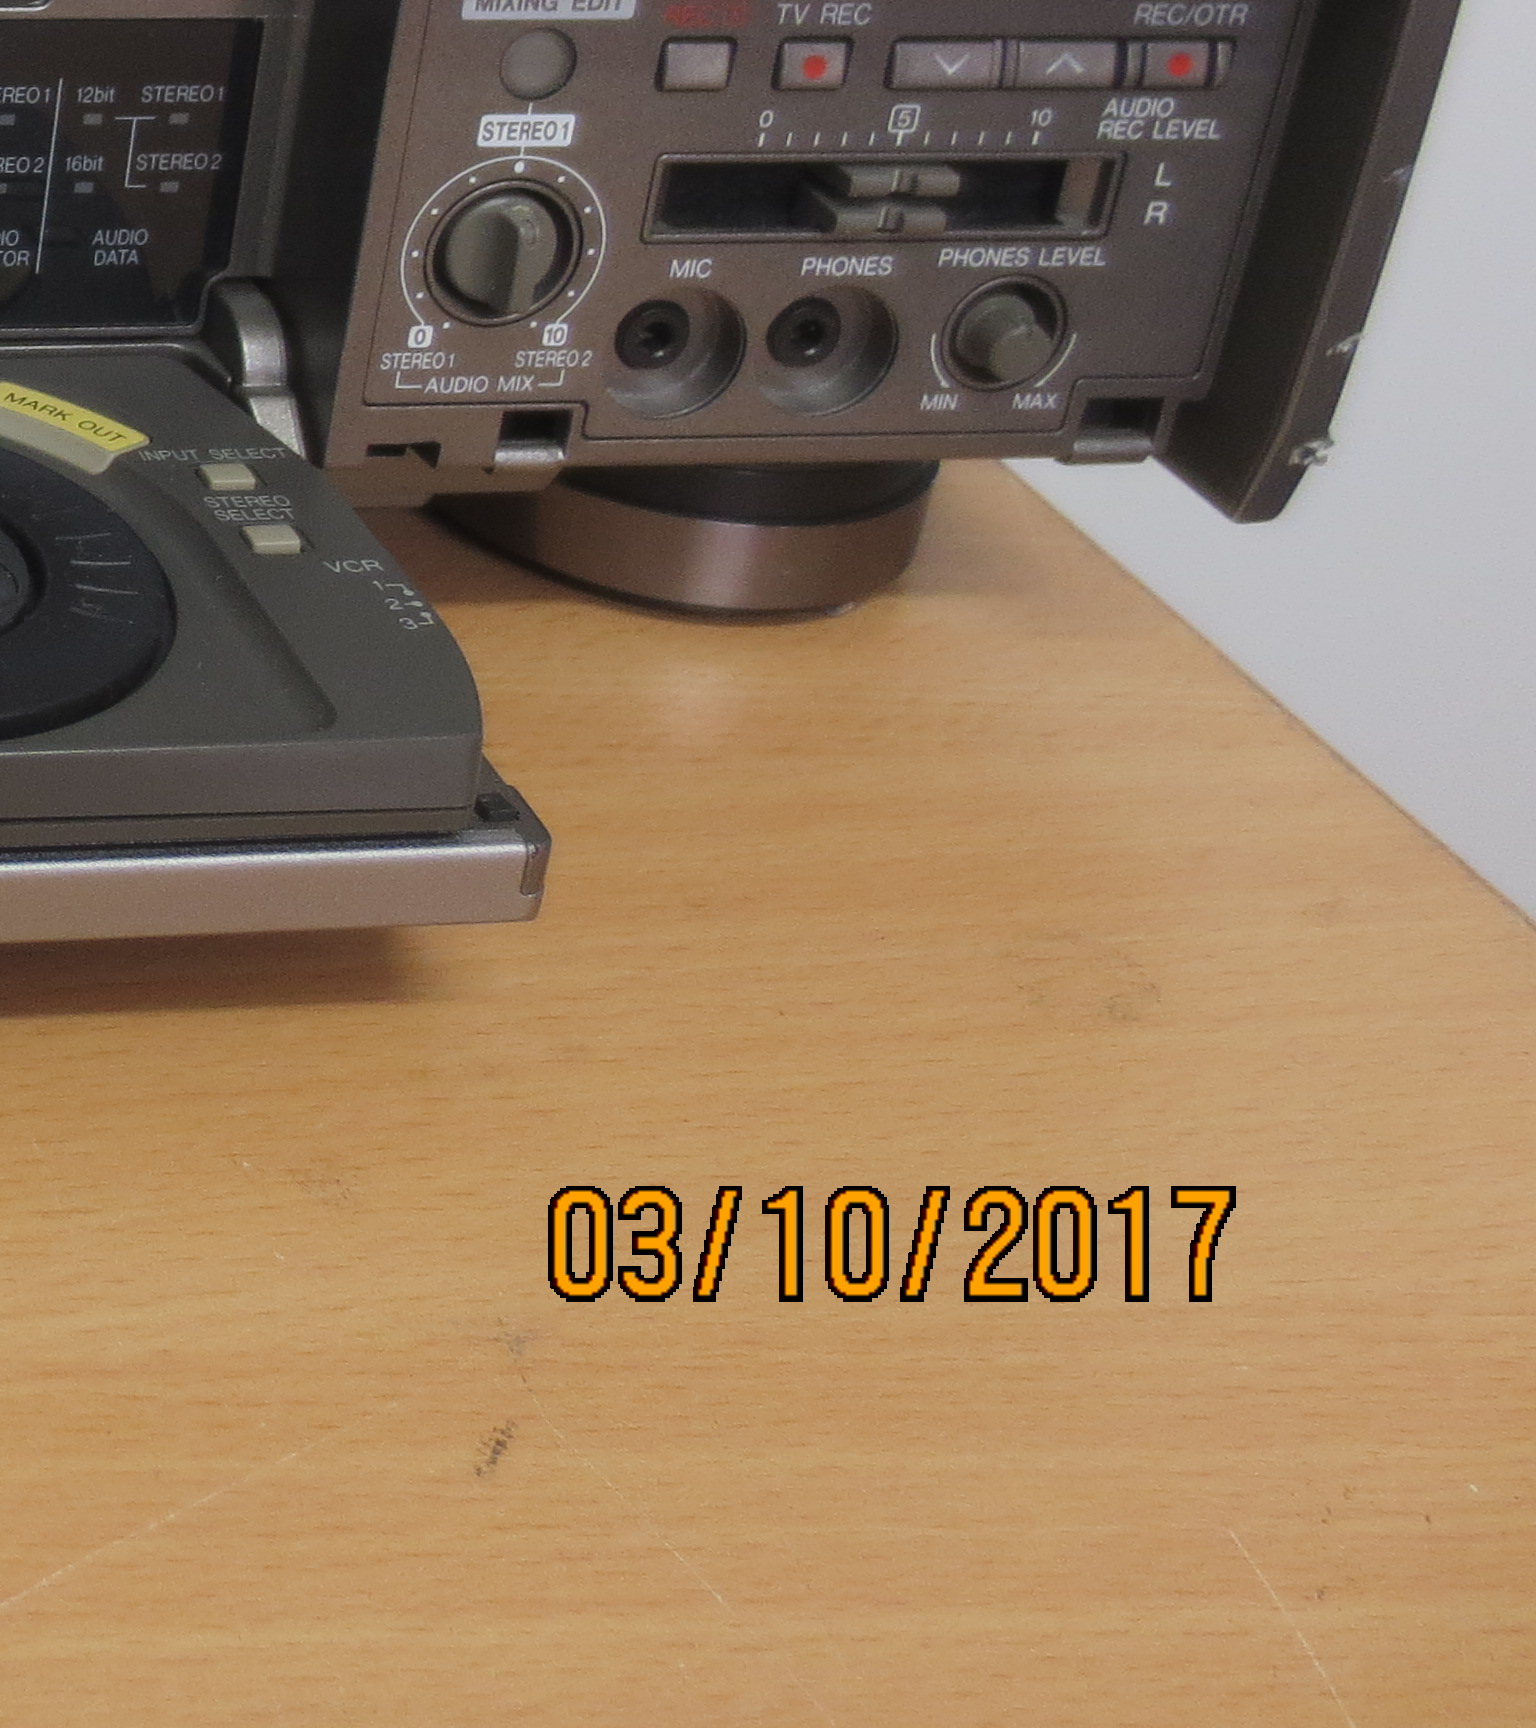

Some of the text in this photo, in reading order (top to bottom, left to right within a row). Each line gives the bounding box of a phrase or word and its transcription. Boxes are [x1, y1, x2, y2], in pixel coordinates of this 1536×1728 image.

[778, 2, 873, 26] TV REC
[1133, 3, 1249, 27] REC/OTR
[77, 87, 116, 104] 12bit
[1102, 97, 1175, 118] AUDIO
[1030, 108, 1052, 126] 10
[1097, 120, 1221, 140] REC LEVEL
[65, 155, 104, 172] 16bit
[1154, 162, 1172, 187] L
[1143, 202, 1168, 225] R
[92, 229, 149, 246] AUDIO
[94, 249, 140, 266] DATA
[938, 247, 1106, 267] PHONES LEVEL
[669, 258, 713, 279] MIC
[801, 256, 894, 277] PHONES
[424, 375, 535, 394] AUDIO MIX
[920, 394, 958, 410] MIN
[1012, 393, 1060, 410] MAX
[3, 391, 131, 445] MARK OUT
[138, 447, 289, 463] INPUT SELECT
[203, 496, 291, 509] STEREO
[213, 508, 295, 522] SELECT
[323, 559, 384, 573] VCR
[384, 598, 403, 610] 2
[399, 617, 417, 631] 3
